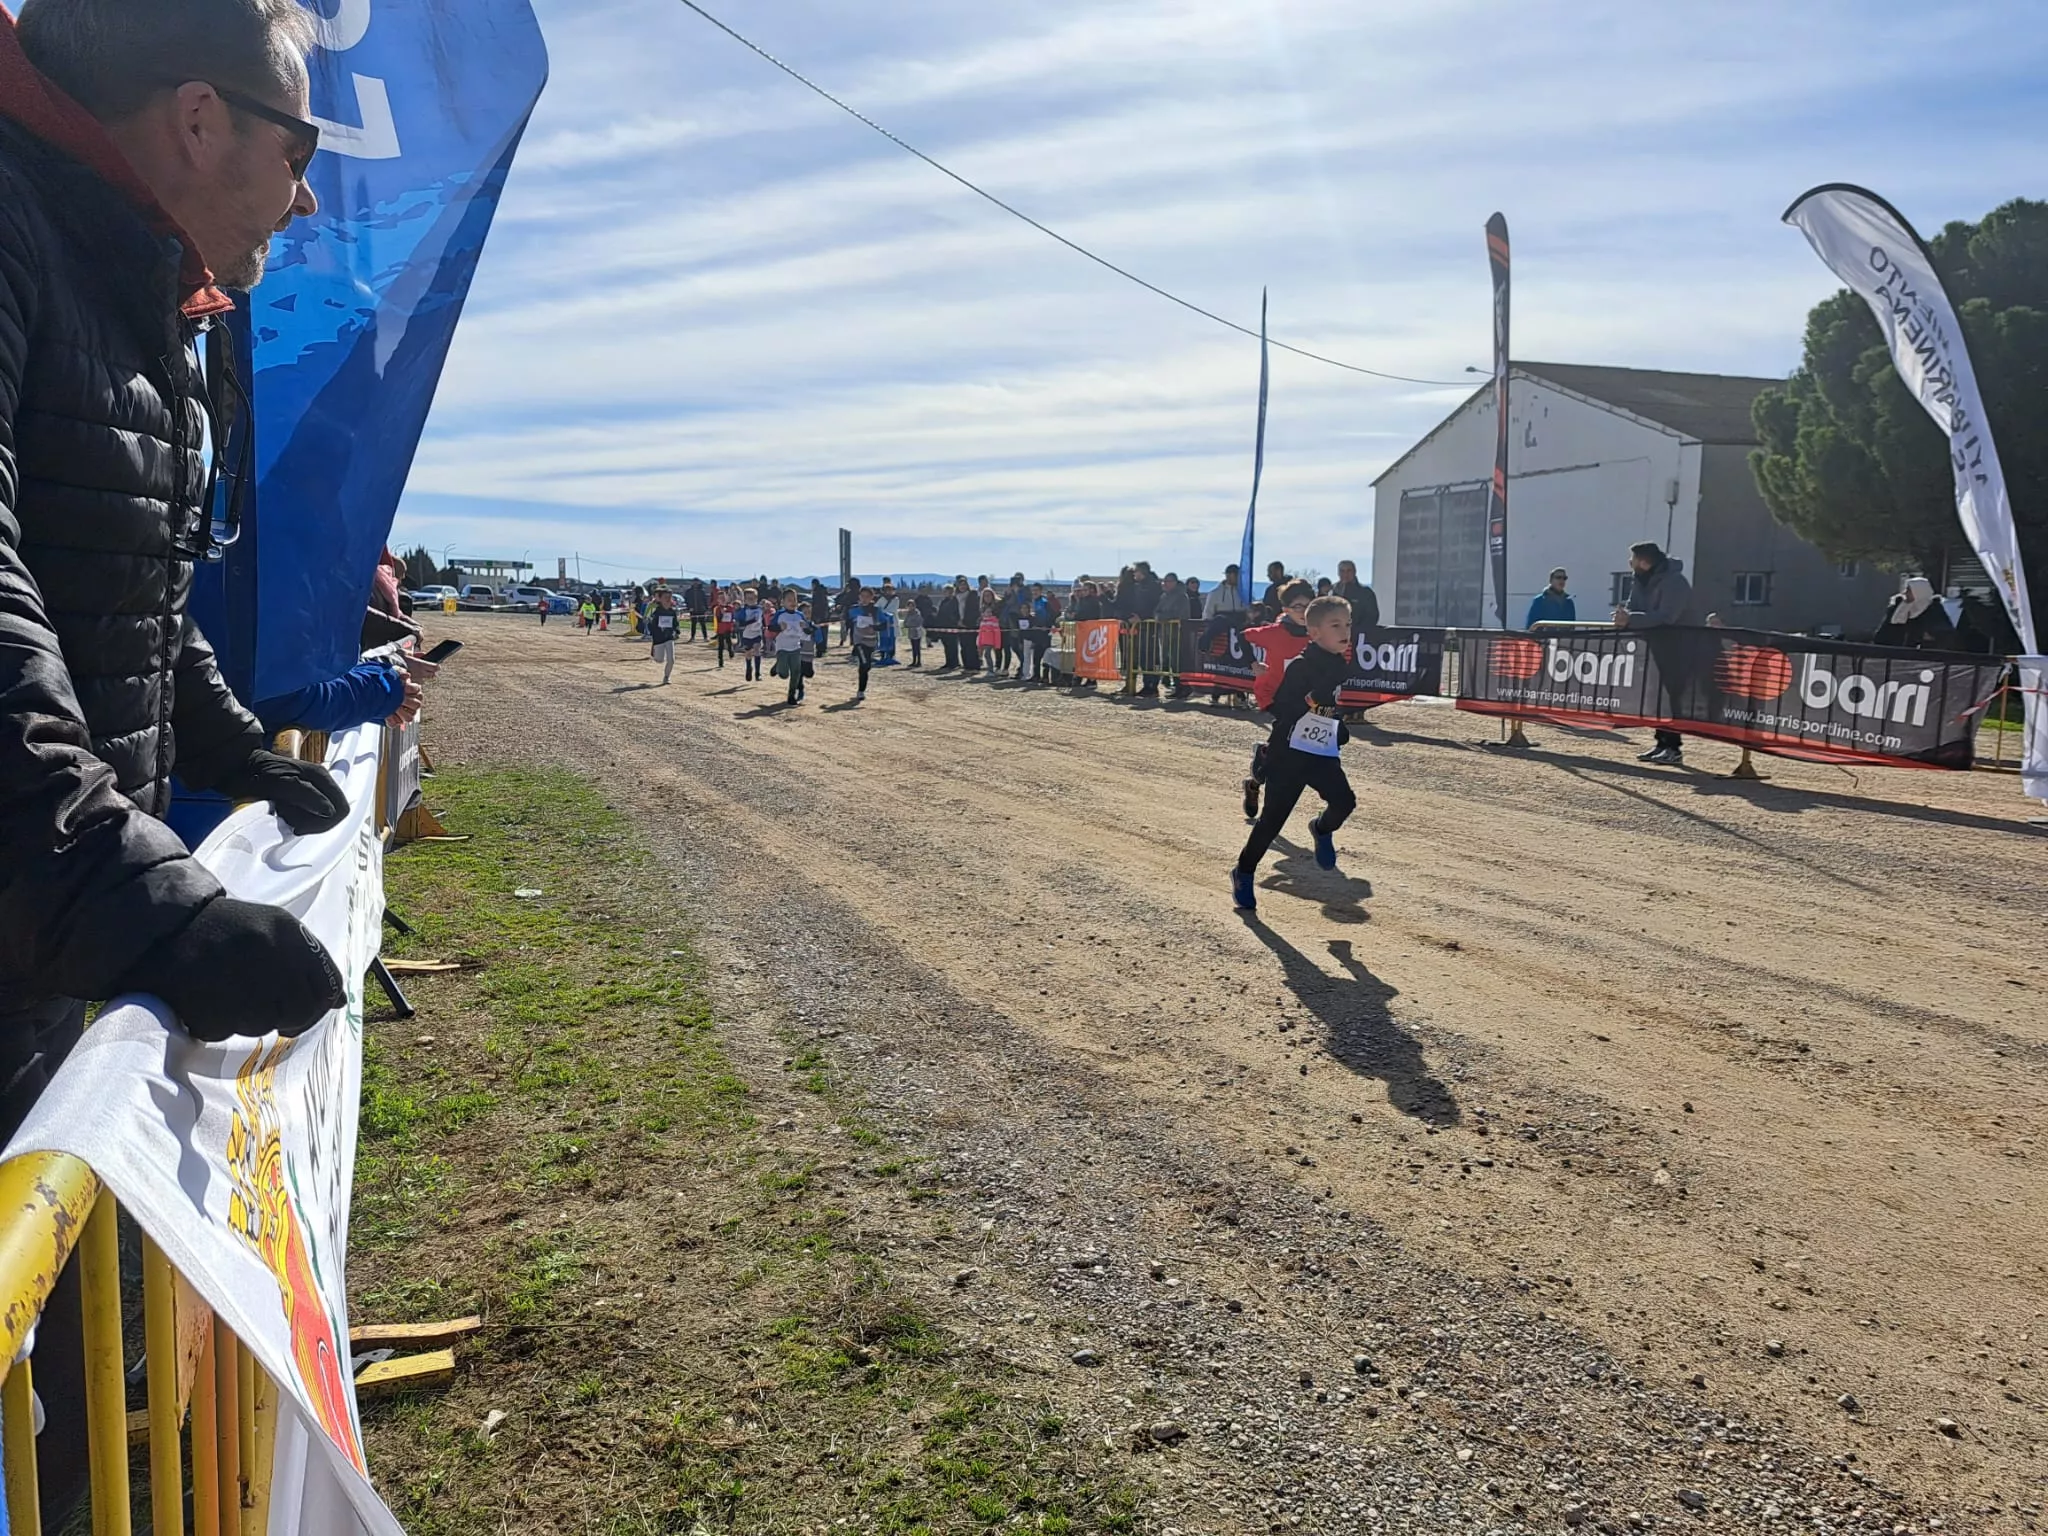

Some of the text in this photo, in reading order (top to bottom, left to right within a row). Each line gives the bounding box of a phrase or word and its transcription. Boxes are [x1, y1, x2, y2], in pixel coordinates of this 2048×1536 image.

[1356, 633, 1420, 673] barri
[1547, 638, 1636, 688] barri
[1496, 686, 1621, 709] www.barrisportline.com
[1800, 653, 1935, 727] barri
[1723, 706, 1902, 749] www.barrisportline.com
